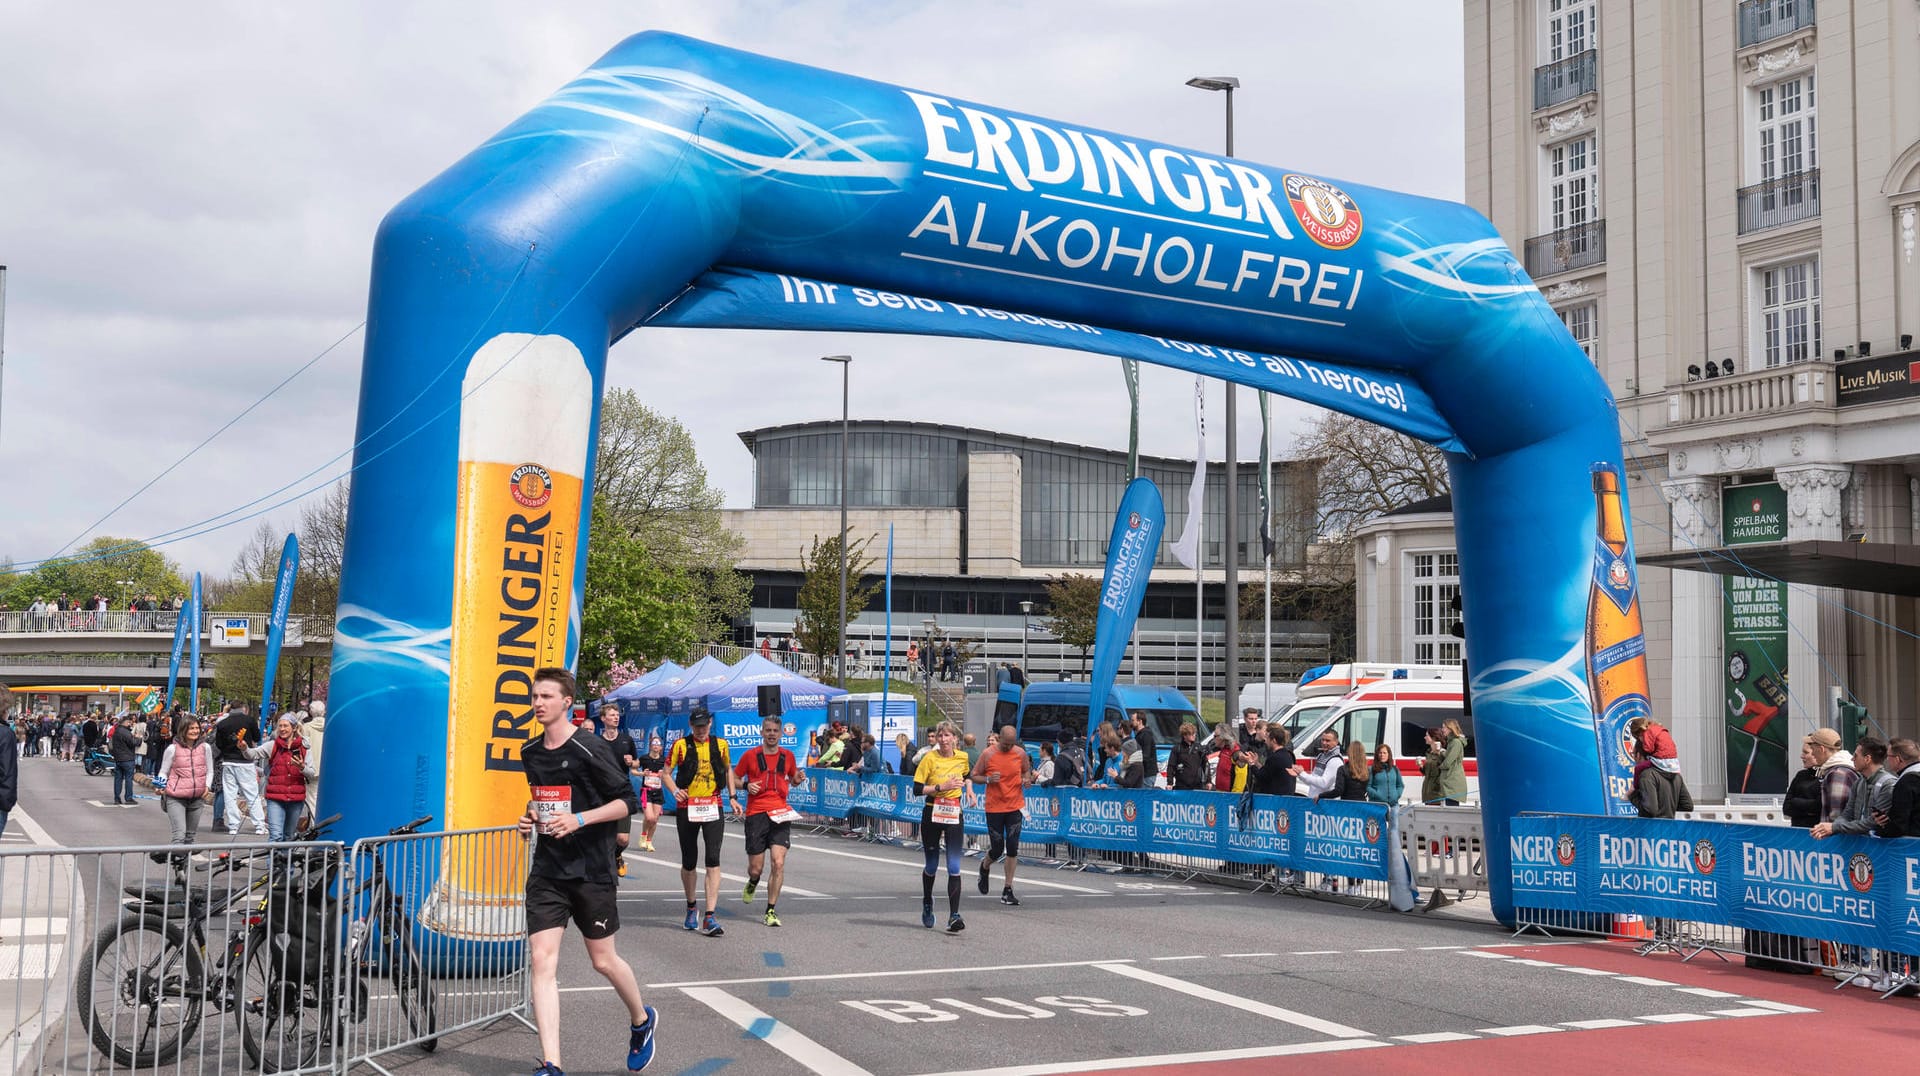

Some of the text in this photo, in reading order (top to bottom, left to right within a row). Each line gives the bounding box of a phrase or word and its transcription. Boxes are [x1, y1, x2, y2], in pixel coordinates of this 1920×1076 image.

[904, 90, 1294, 239] ERDINGER
[1287, 176, 1350, 205] ERDINGER
[907, 195, 1363, 310] ALKOHOLFREI
[775, 273, 838, 304] Ihr
[1261, 356, 1302, 378] all
[1298, 359, 1408, 412] heroes!
[512, 465, 551, 487] ERDINGER
[1732, 525, 1780, 538] HAMBURG
[1733, 513, 1779, 527] SPIELBANK
[1102, 530, 1137, 612] ERDINGER
[545, 530, 564, 664] LKOHOLFREI
[1732, 589, 1779, 603] VON DER
[1733, 615, 1783, 628] STRASSE.
[484, 510, 551, 772] ERDINGER
[964, 675, 973, 687] P
[731, 696, 758, 704] ERDINGE
[723, 724, 763, 738] ERDIN
[540, 789, 560, 797] Haspa
[537, 802, 556, 812] 534
[1024, 797, 1051, 818] INGER
[1070, 796, 1123, 822] ERDINGER
[1152, 800, 1206, 827] ERDINGER
[1068, 822, 1137, 837] ALKOHOLFREI
[1152, 826, 1217, 844] ALKOHOLFREI
[1304, 810, 1366, 844] ERDINGER
[1228, 833, 1290, 851] ALKOHOLFREI
[1304, 840, 1381, 862] ALKOHOLFREI
[1510, 835, 1557, 867] NGER
[1599, 833, 1695, 874] ERDINGER
[1511, 869, 1577, 888] HOLFREI
[1742, 842, 1849, 892] ERDINGER
[1599, 873, 1718, 899] ALKOHOLFREI
[1744, 885, 1876, 920] ALKOHOLFREI
[839, 995, 1149, 1024] BUS
